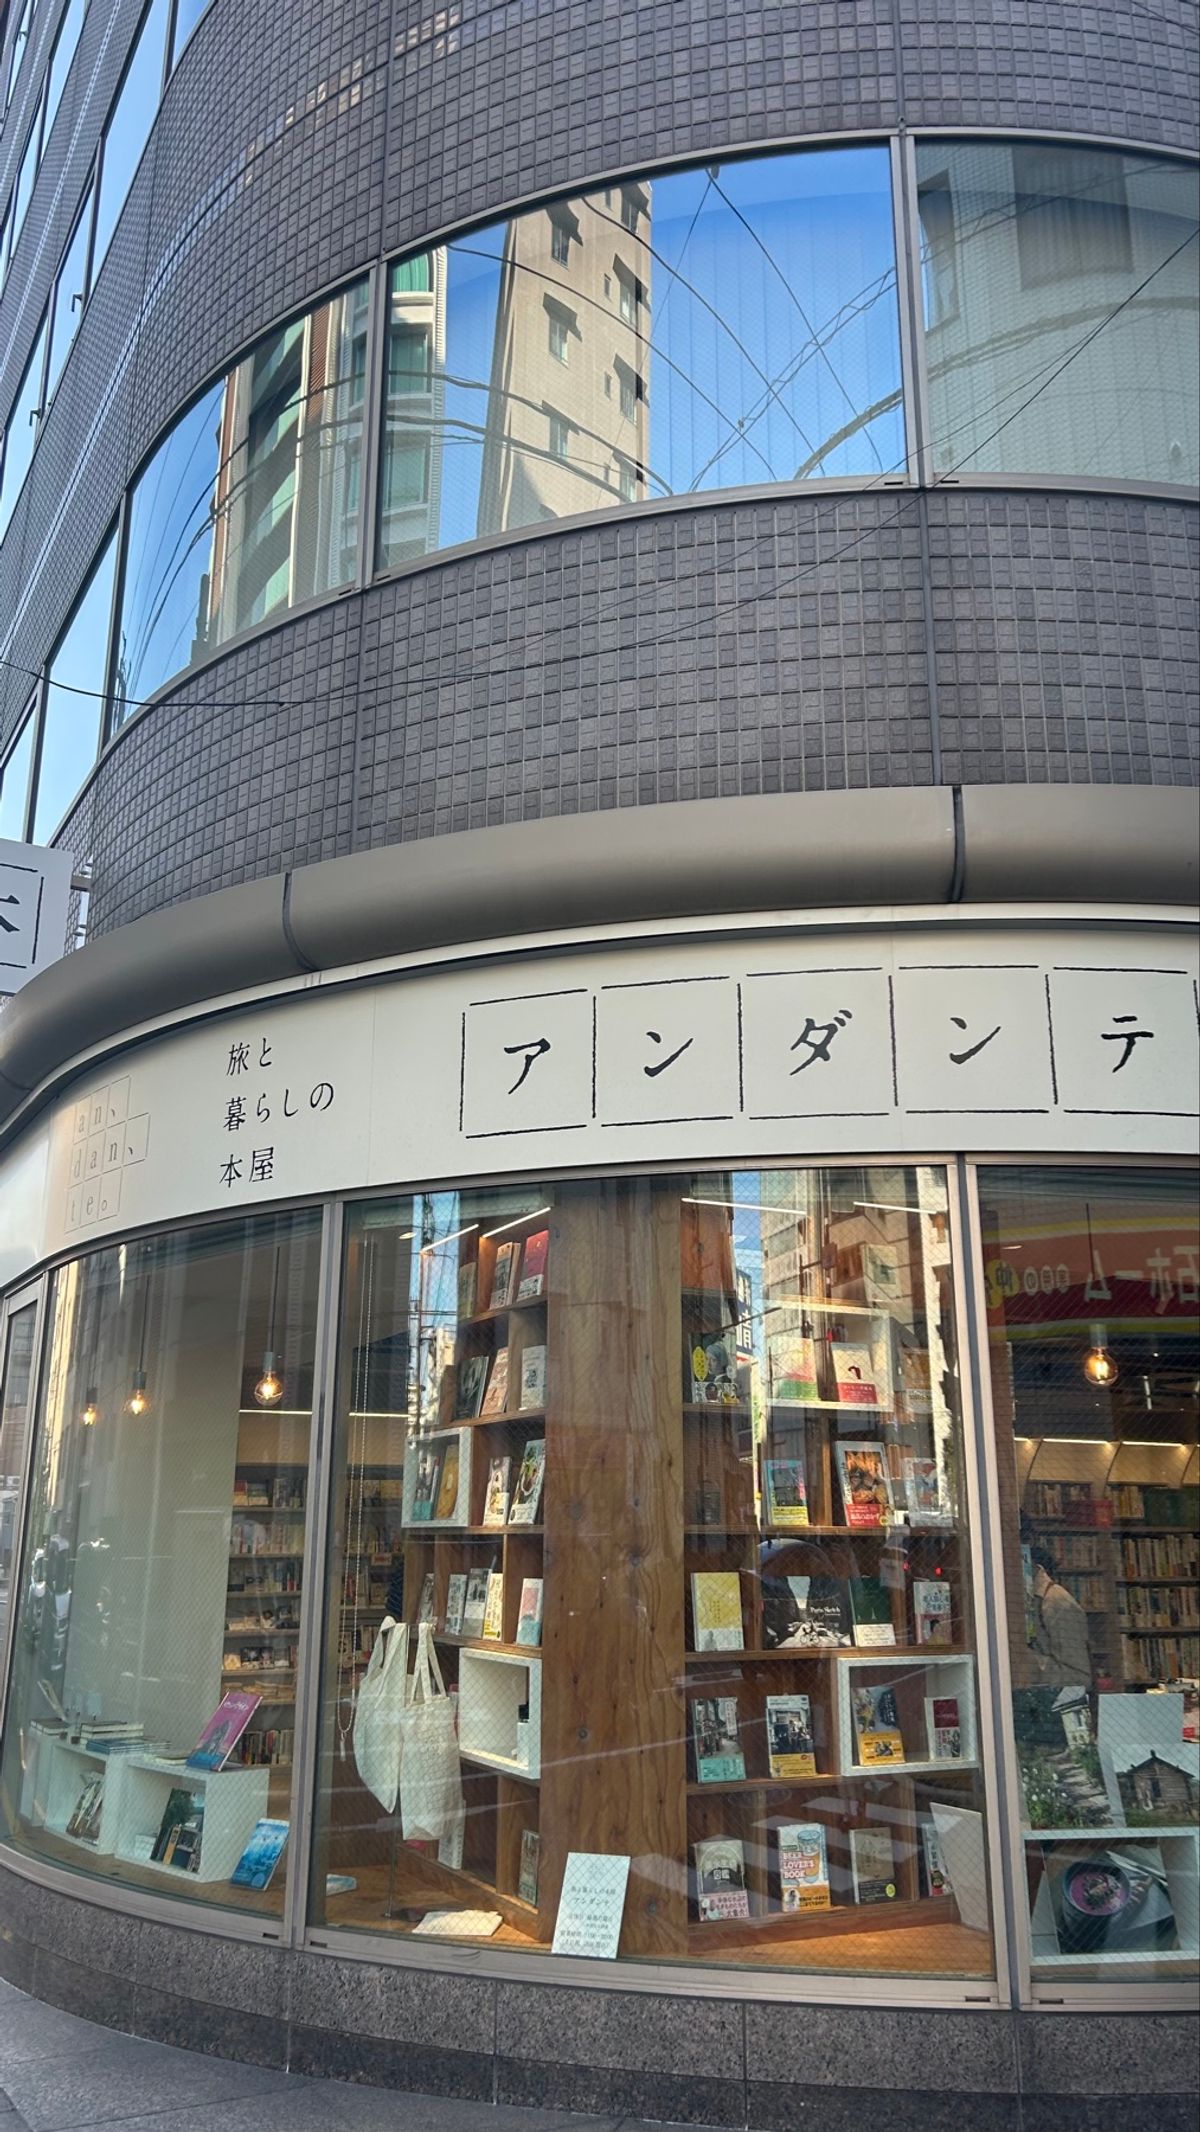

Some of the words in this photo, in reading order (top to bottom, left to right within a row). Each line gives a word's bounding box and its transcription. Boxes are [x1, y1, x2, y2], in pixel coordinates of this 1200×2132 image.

[227, 1037, 274, 1076] 旅と
[503, 1008, 1155, 1096] アンダンテ
[223, 1082, 334, 1132] 暮らしの
[219, 1146, 275, 1188] 本屋
